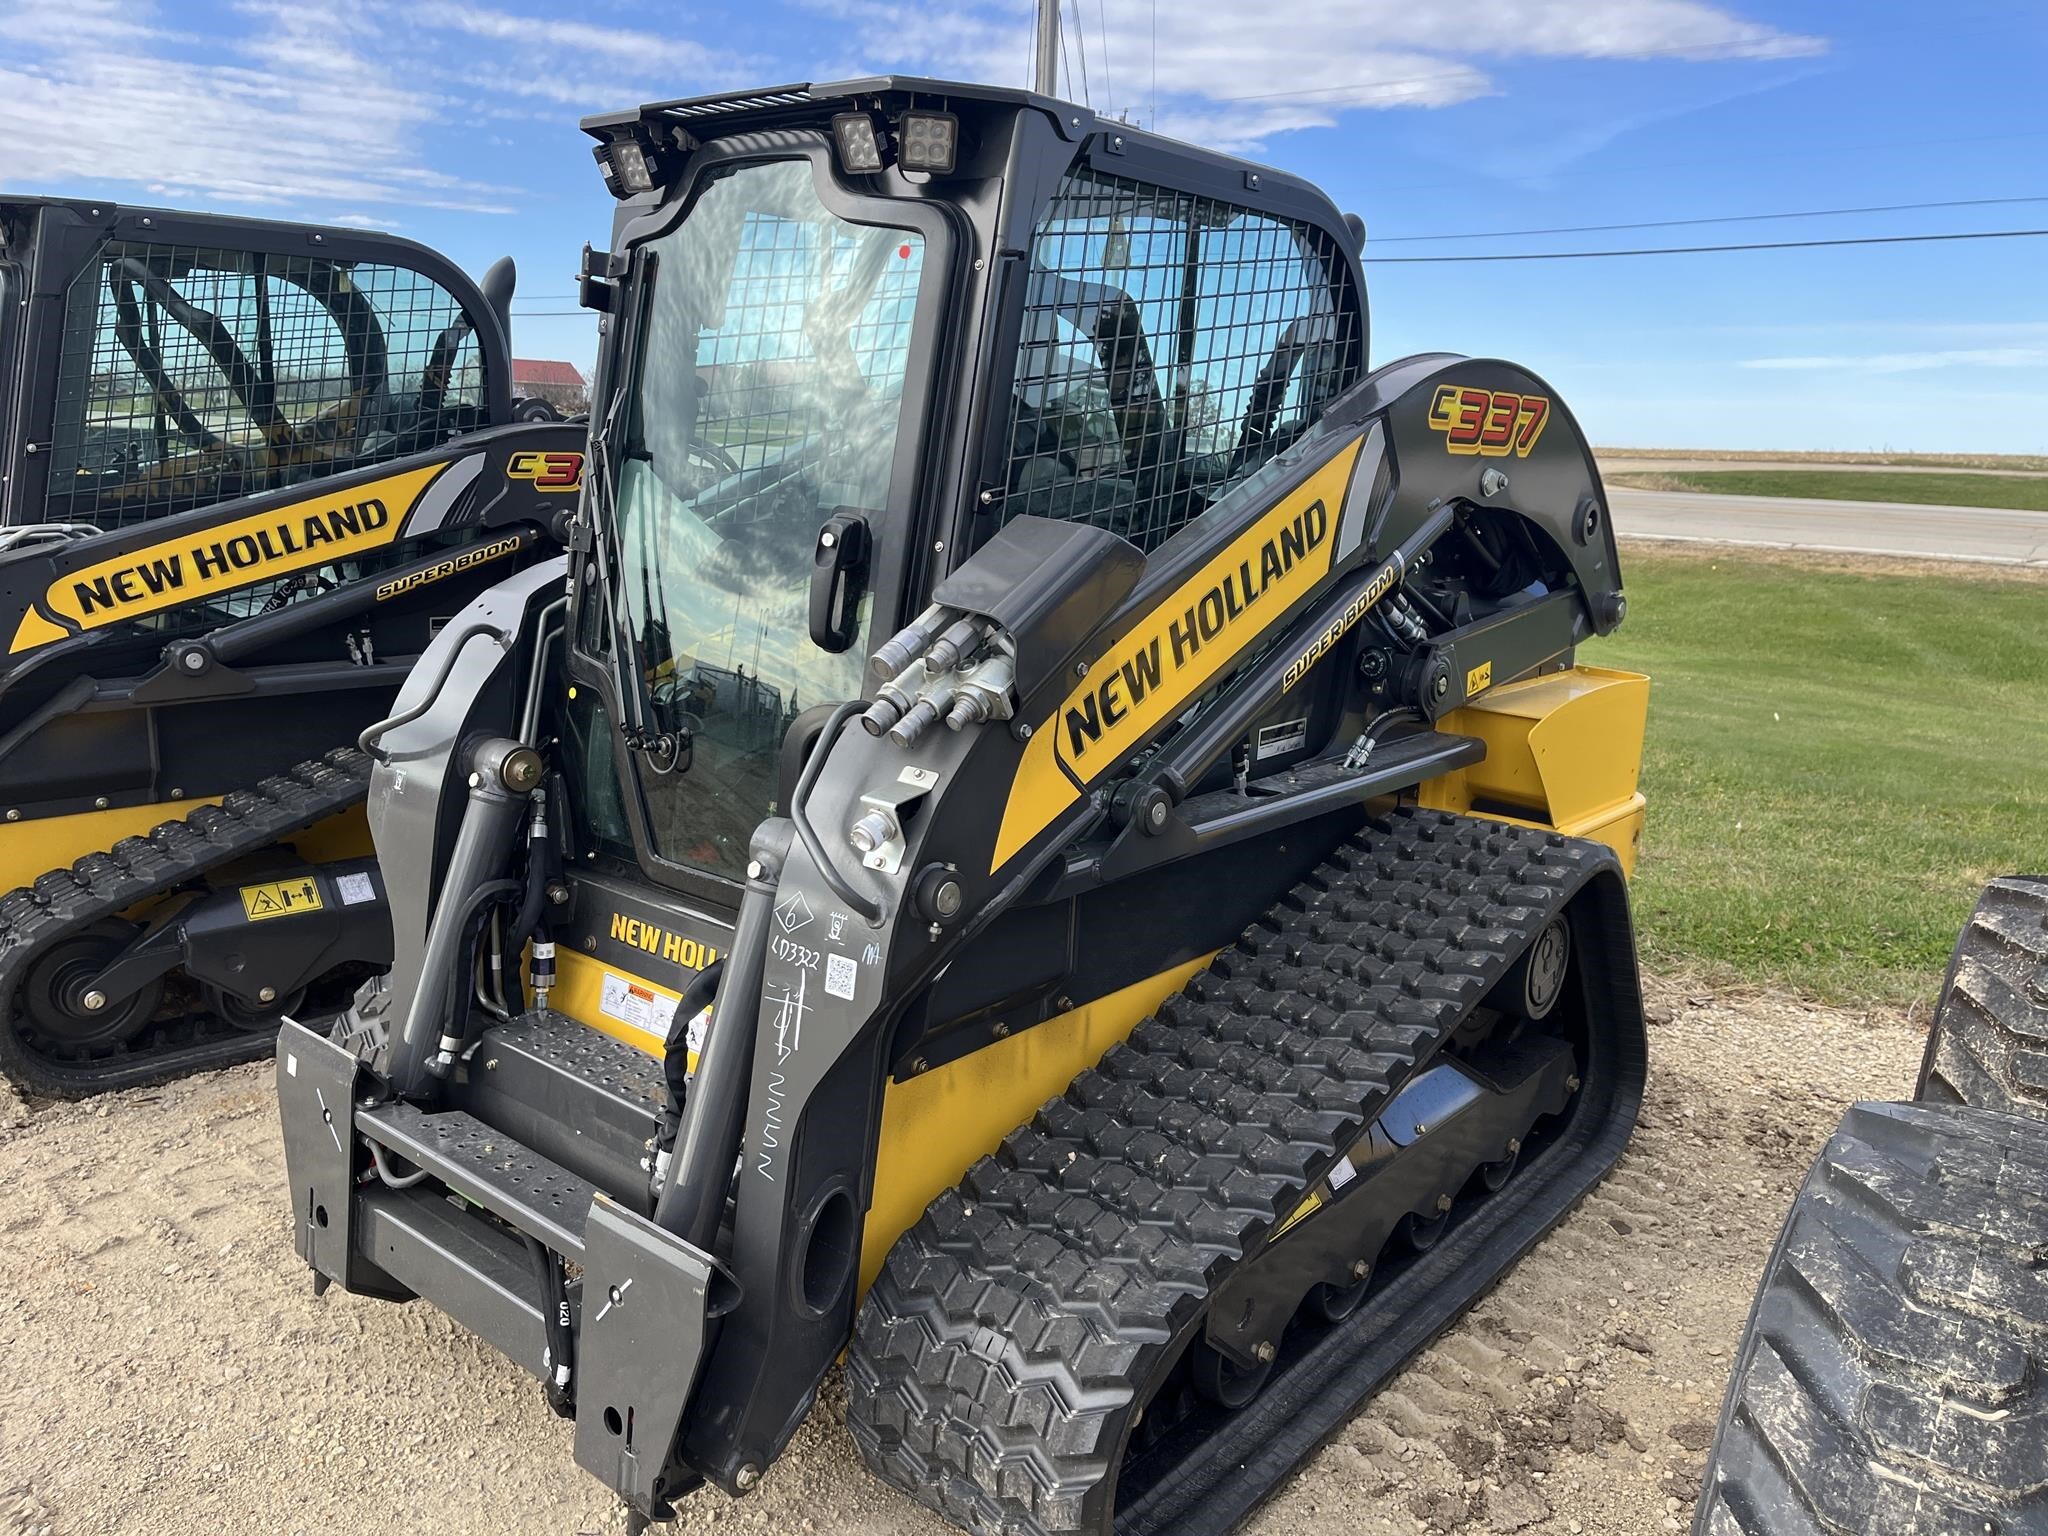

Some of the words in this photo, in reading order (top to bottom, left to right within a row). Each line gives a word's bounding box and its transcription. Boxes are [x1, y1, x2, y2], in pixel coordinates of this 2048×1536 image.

[1428, 384, 1550, 458] C337
[508, 452, 587, 492] C3
[73, 555, 184, 615] NEW
[192, 498, 389, 580] HOLLAND
[376, 561, 454, 600] SUPER
[455, 536, 520, 572] BOOM
[1064, 635, 1163, 760] NEW
[1167, 498, 1328, 671] HOLLAND
[1283, 618, 1344, 694] SUPER
[1343, 566, 1393, 631] BOOM
[610, 912, 662, 955] NEW
[663, 931, 728, 972] HOLL
[785, 896, 801, 928] 6
